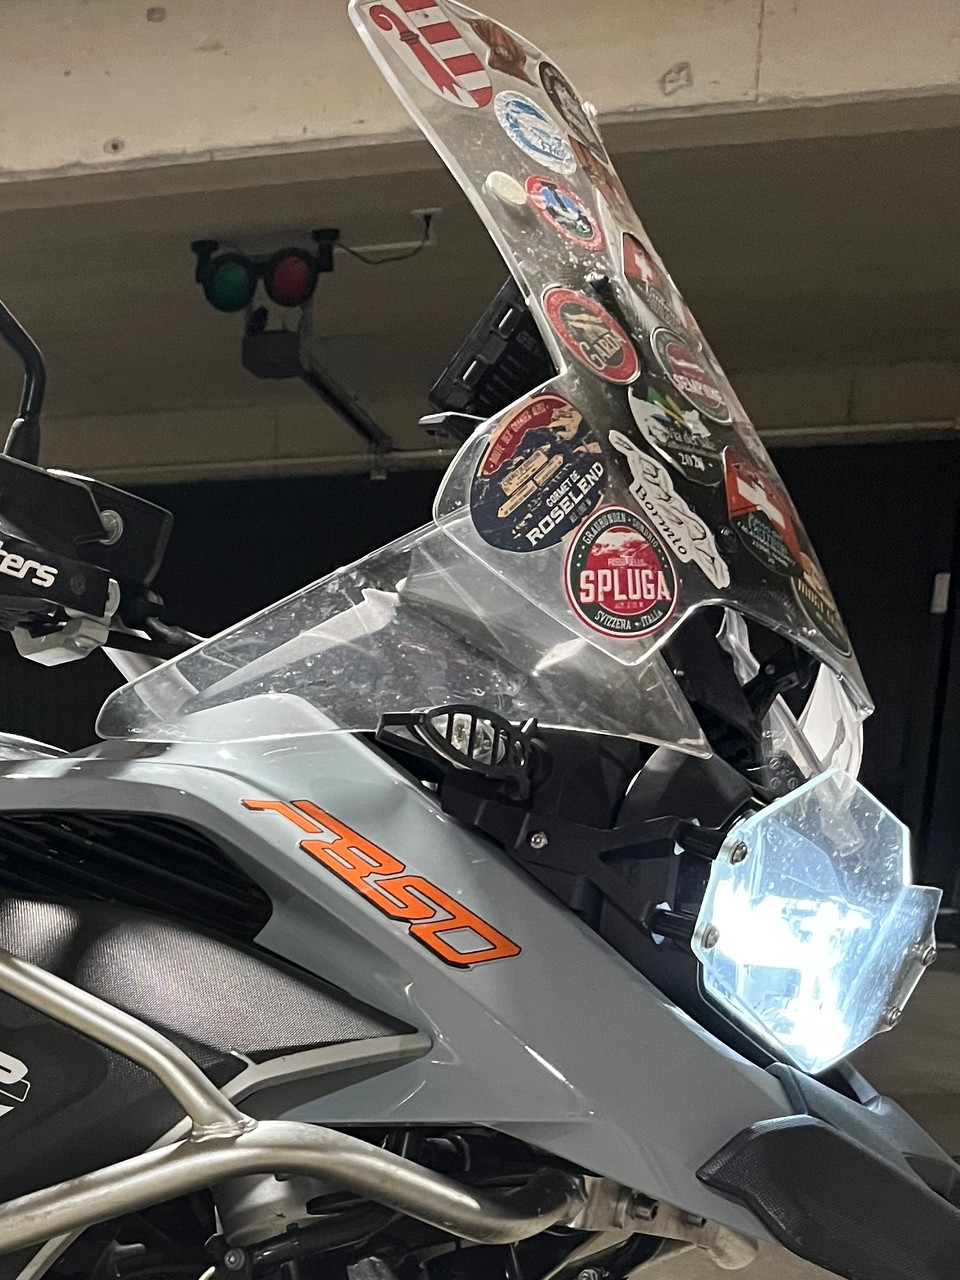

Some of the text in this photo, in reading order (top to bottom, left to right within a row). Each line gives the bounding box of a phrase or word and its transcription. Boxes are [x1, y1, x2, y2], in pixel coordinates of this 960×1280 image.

[569, 470, 581, 483] DE
[525, 461, 605, 547] ROSELEND
[634, 484, 688, 556] Bormio
[580, 568, 672, 603] SPLUGA
[594, 610, 632, 630] SVIZZERA
